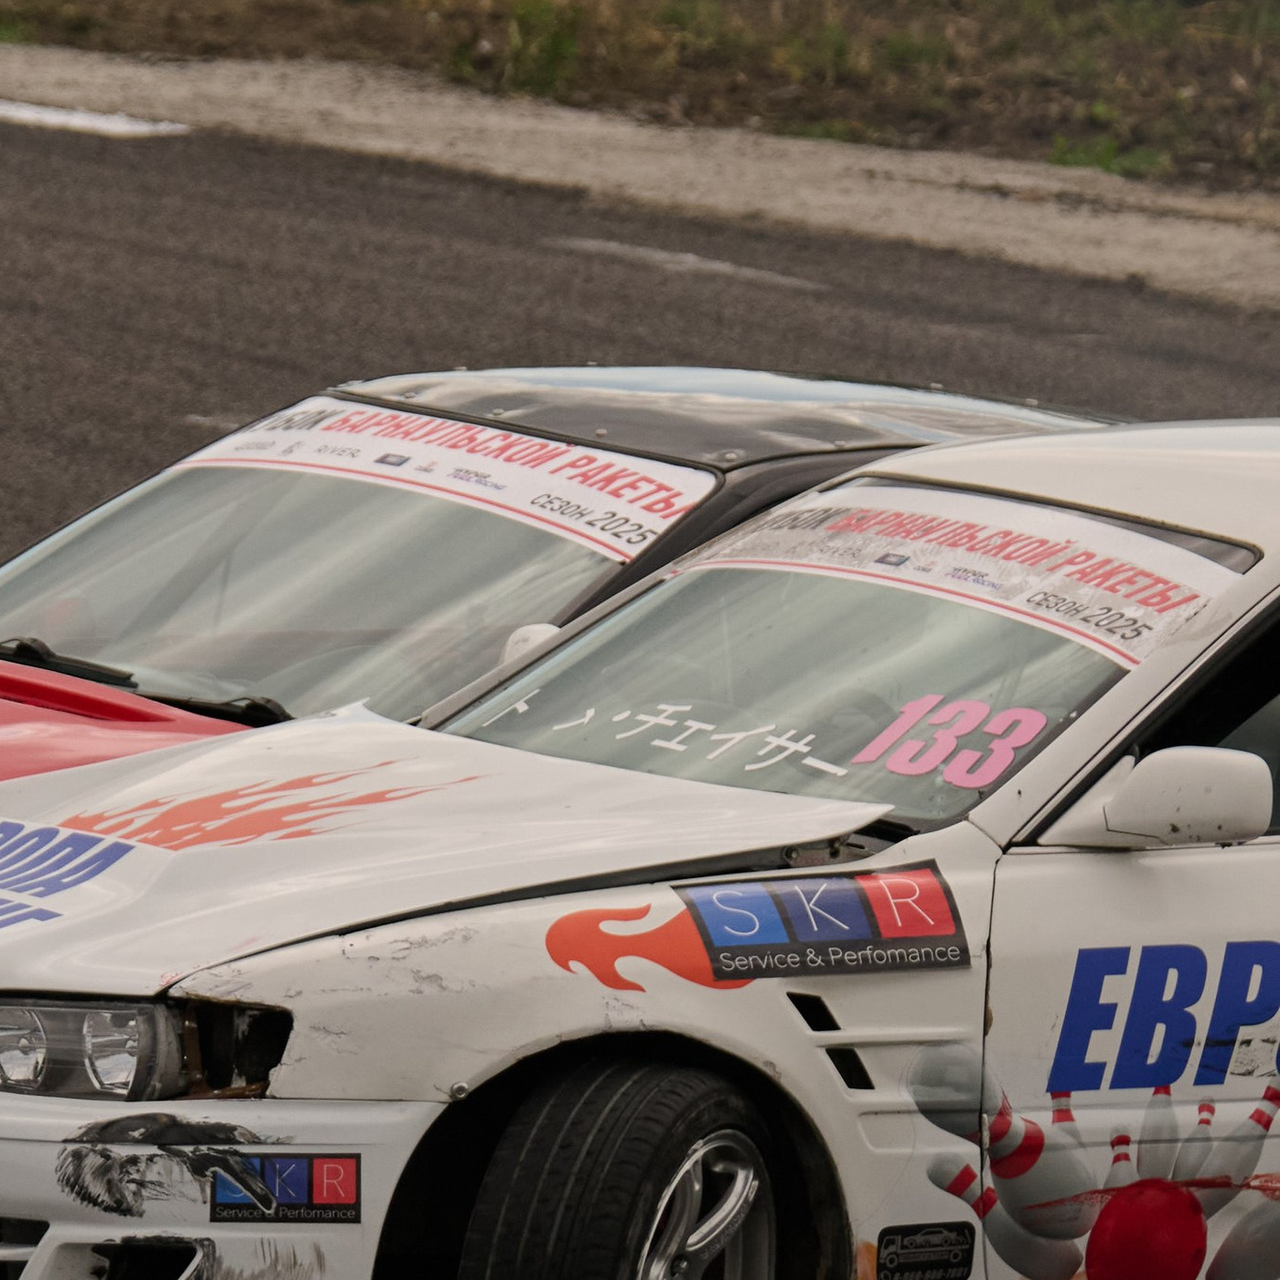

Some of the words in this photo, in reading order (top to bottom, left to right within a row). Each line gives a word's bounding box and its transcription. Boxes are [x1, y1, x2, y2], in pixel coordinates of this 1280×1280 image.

[314, 444, 361, 459] RIVER
[320, 410, 576, 469] БАРНАУЛЬСКОЙ
[549, 454, 697, 520] РАКЕТЫ
[530, 493, 591, 520] СЕЗОН
[585, 510, 658, 545] 2025
[825, 509, 1077, 567] БАРНАУЛЬСКОЙ
[1046, 550, 1200, 614] РАКЕТЫ
[1026, 591, 1090, 617] СЕЗОН
[1079, 606, 1155, 641] 2025
[851, 693, 1048, 789] 133
[712, 878, 935, 938] SKR
[719, 950, 801, 973] Service
[806, 947, 825, 967] &
[830, 941, 962, 967] Perfomance
[1046, 940, 1280, 1093] ЕВР
[215, 1206, 263, 1219] Service
[279, 1206, 356, 1219] Perfomance
